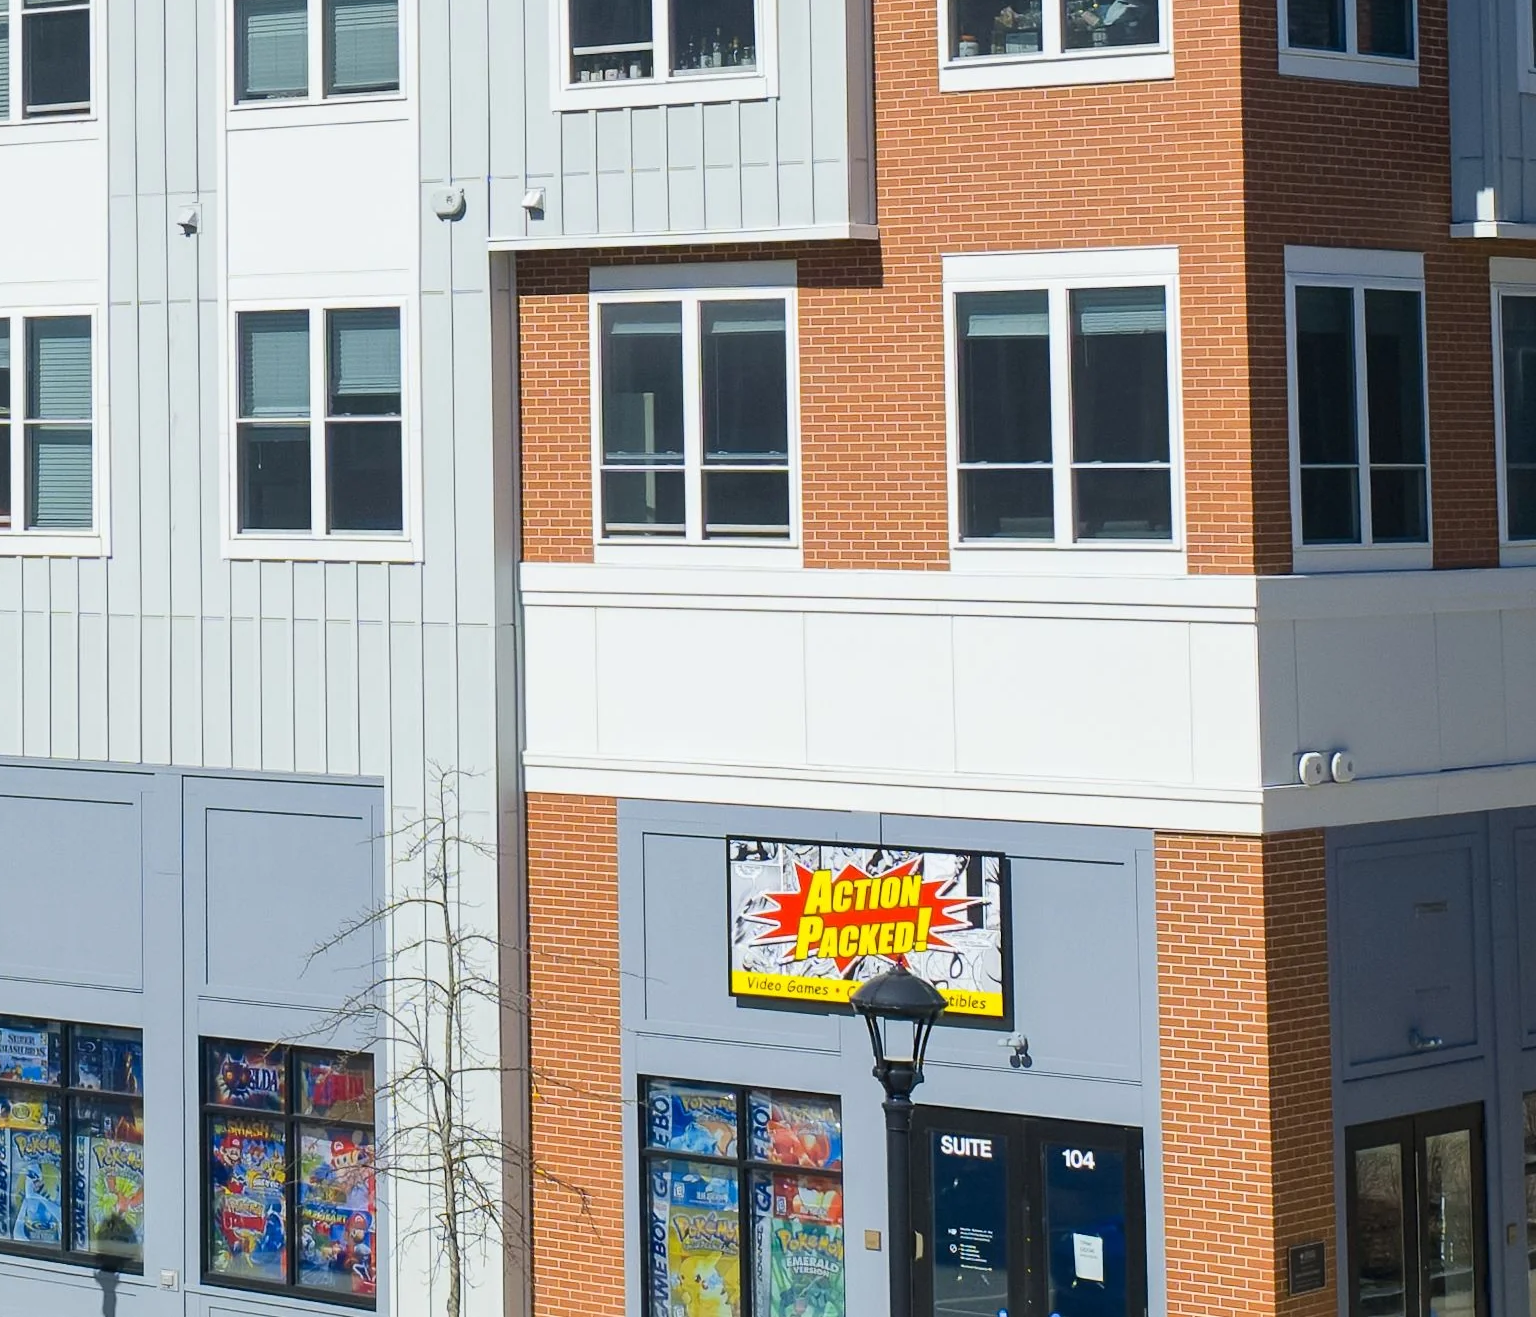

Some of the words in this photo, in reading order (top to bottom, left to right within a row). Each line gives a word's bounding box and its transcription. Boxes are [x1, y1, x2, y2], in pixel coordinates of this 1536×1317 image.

[804, 869, 922, 915] ACTION
[795, 907, 933, 961] PACKED!
[747, 979, 782, 992] Video
[787, 980, 829, 996] Games
[941, 1135, 993, 1159] SUITE
[1062, 1149, 1096, 1170] 104
[652, 1212, 669, 1260] BOY
[786, 1255, 840, 1273] EMERALD
[793, 1266, 830, 1279] VERSION
